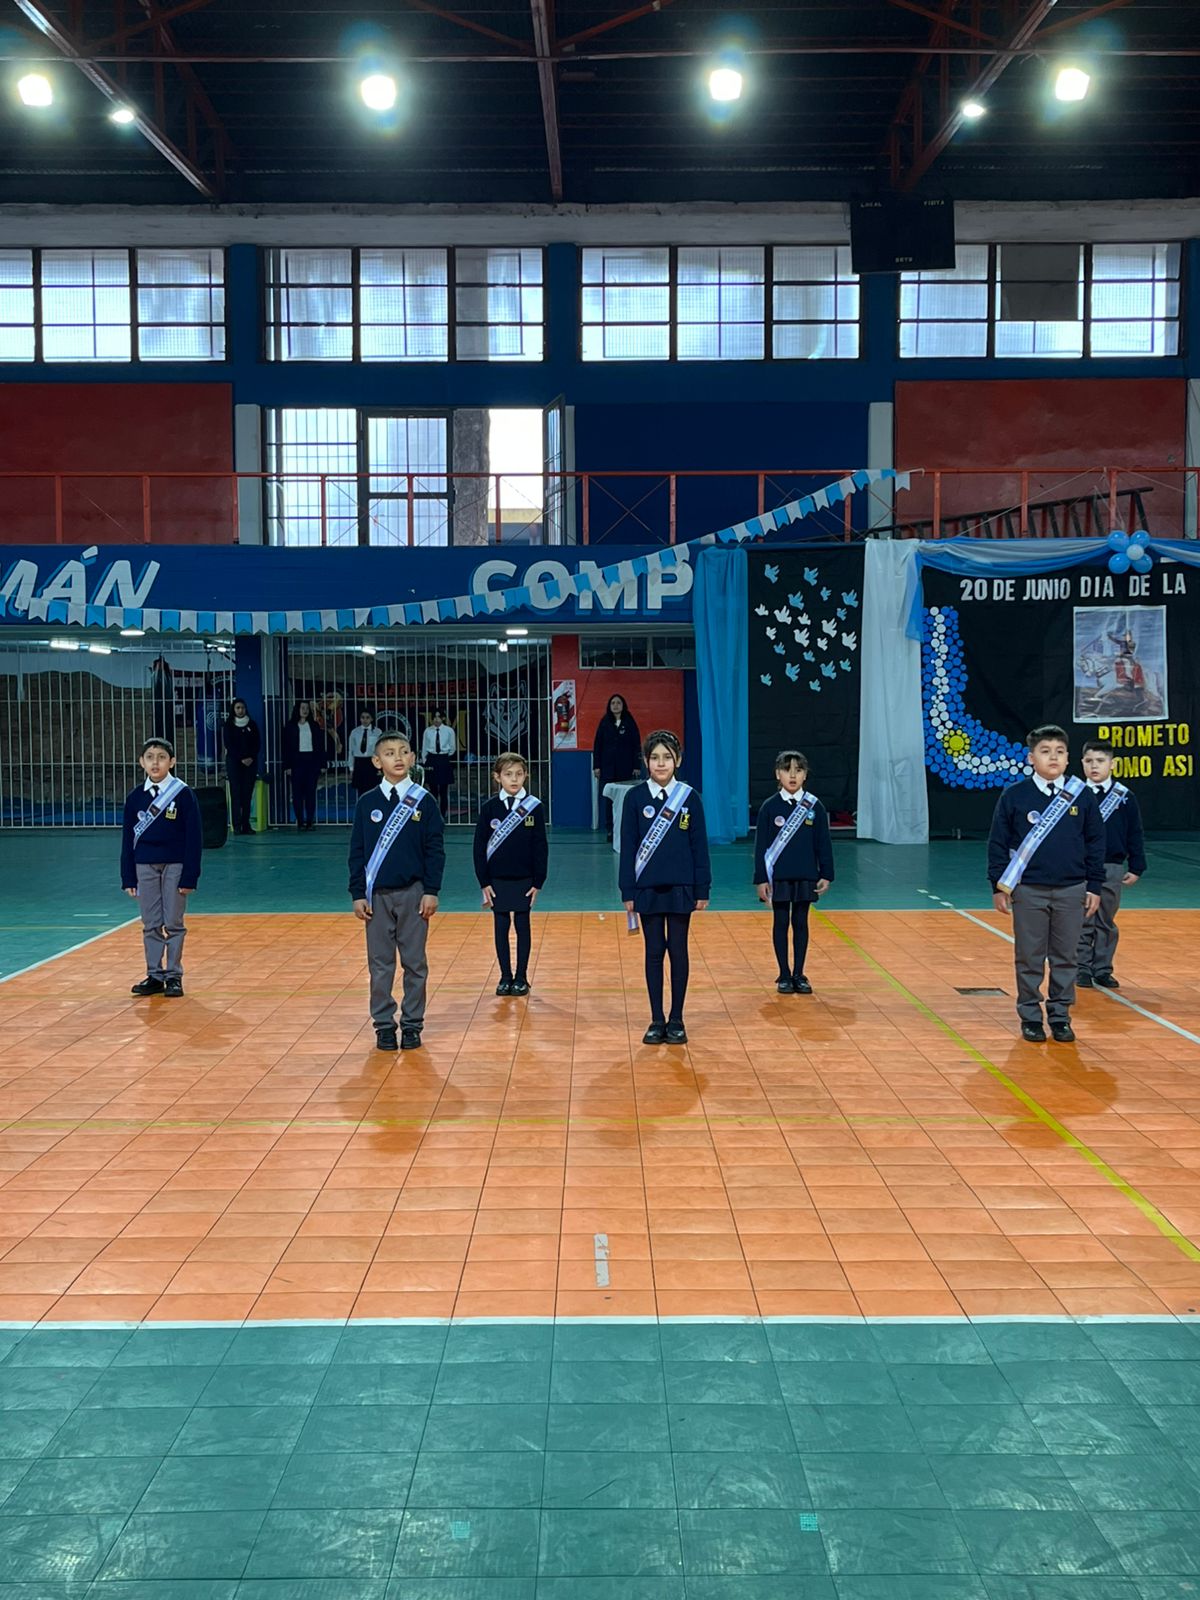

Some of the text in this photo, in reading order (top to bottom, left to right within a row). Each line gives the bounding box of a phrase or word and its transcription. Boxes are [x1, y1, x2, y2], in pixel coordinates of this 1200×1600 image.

[472, 558, 694, 610] COMP
[960, 573, 1187, 601] 20 DE JUNIO DIA DE LA
[1098, 723, 1190, 748] PROMETO
[1111, 754, 1193, 778] OMO ASI
